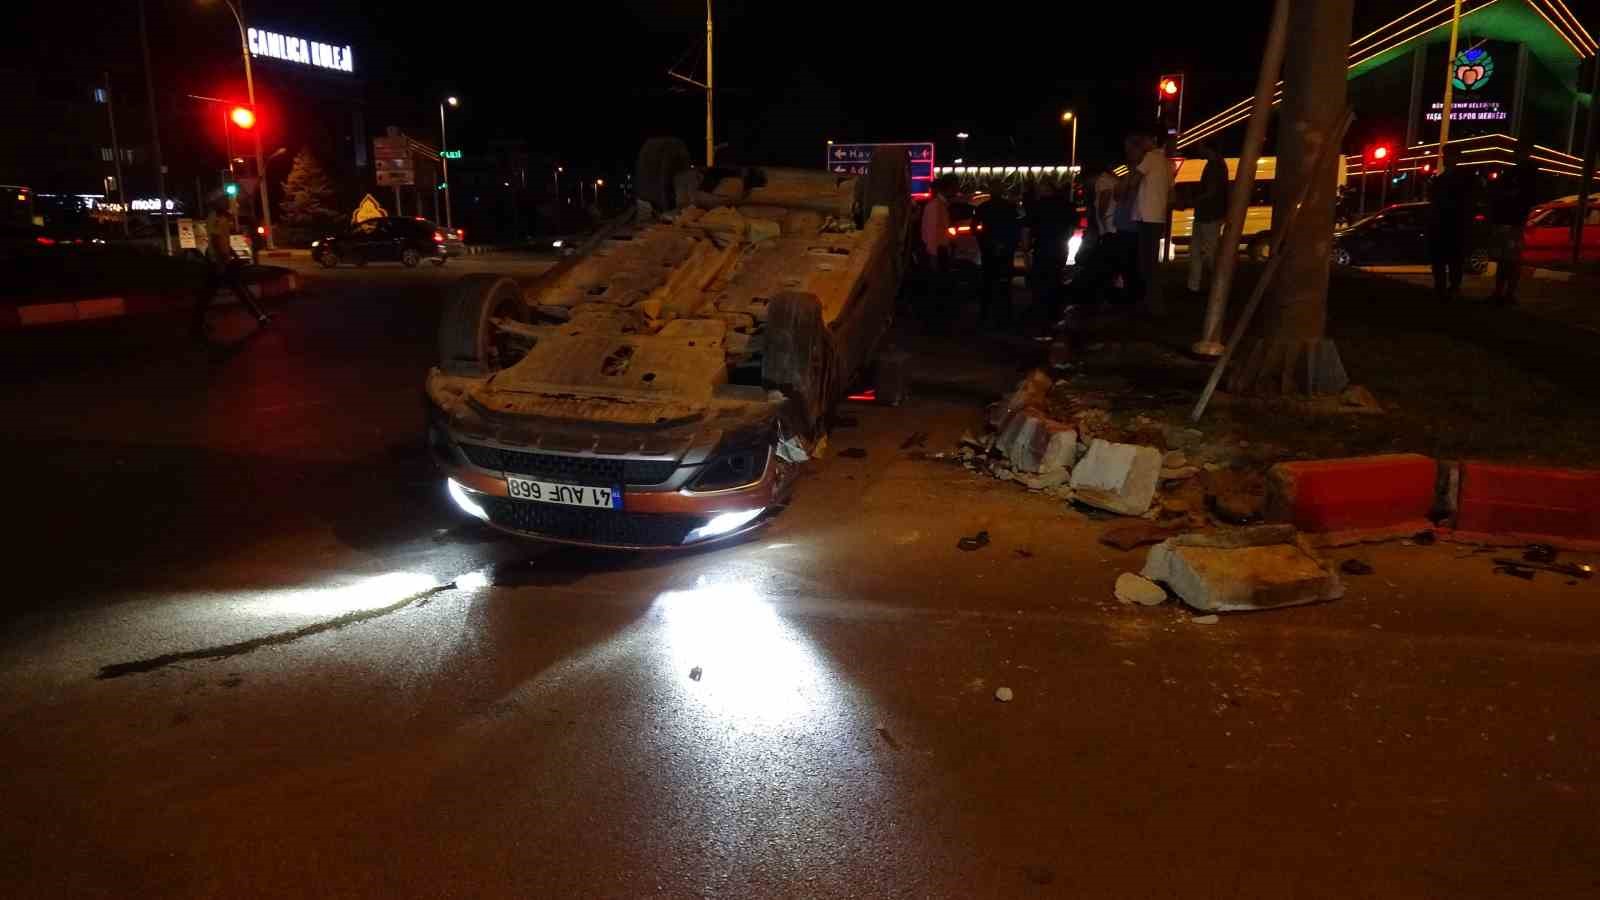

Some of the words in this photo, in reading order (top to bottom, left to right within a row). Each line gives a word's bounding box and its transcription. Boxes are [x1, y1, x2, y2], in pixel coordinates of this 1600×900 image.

[247, 27, 311, 65] ÇAMLICA
[510, 479, 542, 499] 668
[548, 485, 585, 504] AUF
[592, 488, 611, 506] 41
